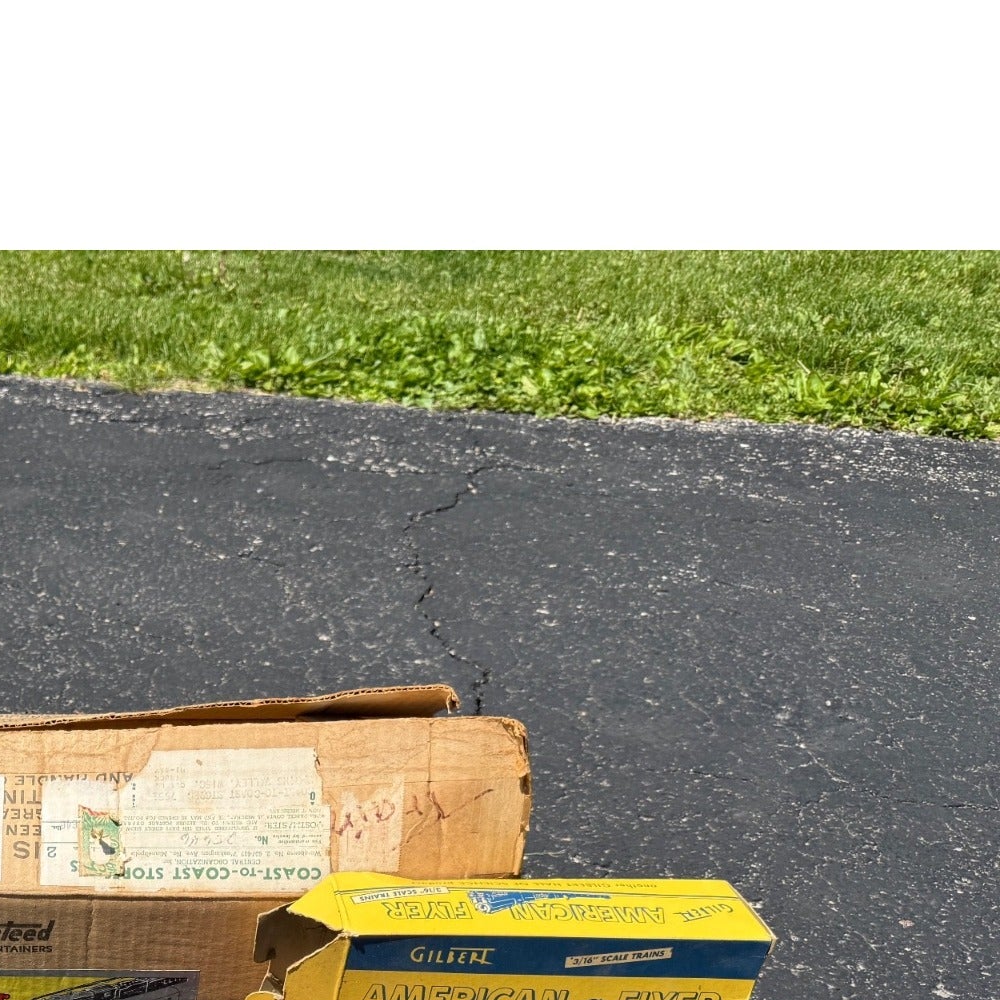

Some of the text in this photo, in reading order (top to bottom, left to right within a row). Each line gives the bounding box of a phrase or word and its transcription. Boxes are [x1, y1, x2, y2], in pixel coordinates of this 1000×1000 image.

[254, 835, 269, 845] No.
[46, 846, 57, 858] 2
[358, 892, 391, 902] TRAINS
[392, 889, 418, 898] SCALE
[380, 901, 666, 925] AMERICAN FLYER
[410, 946, 496, 965] GILBERT
[600, 953, 629, 963] SCALE
[631, 950, 665, 960] TRAINS
